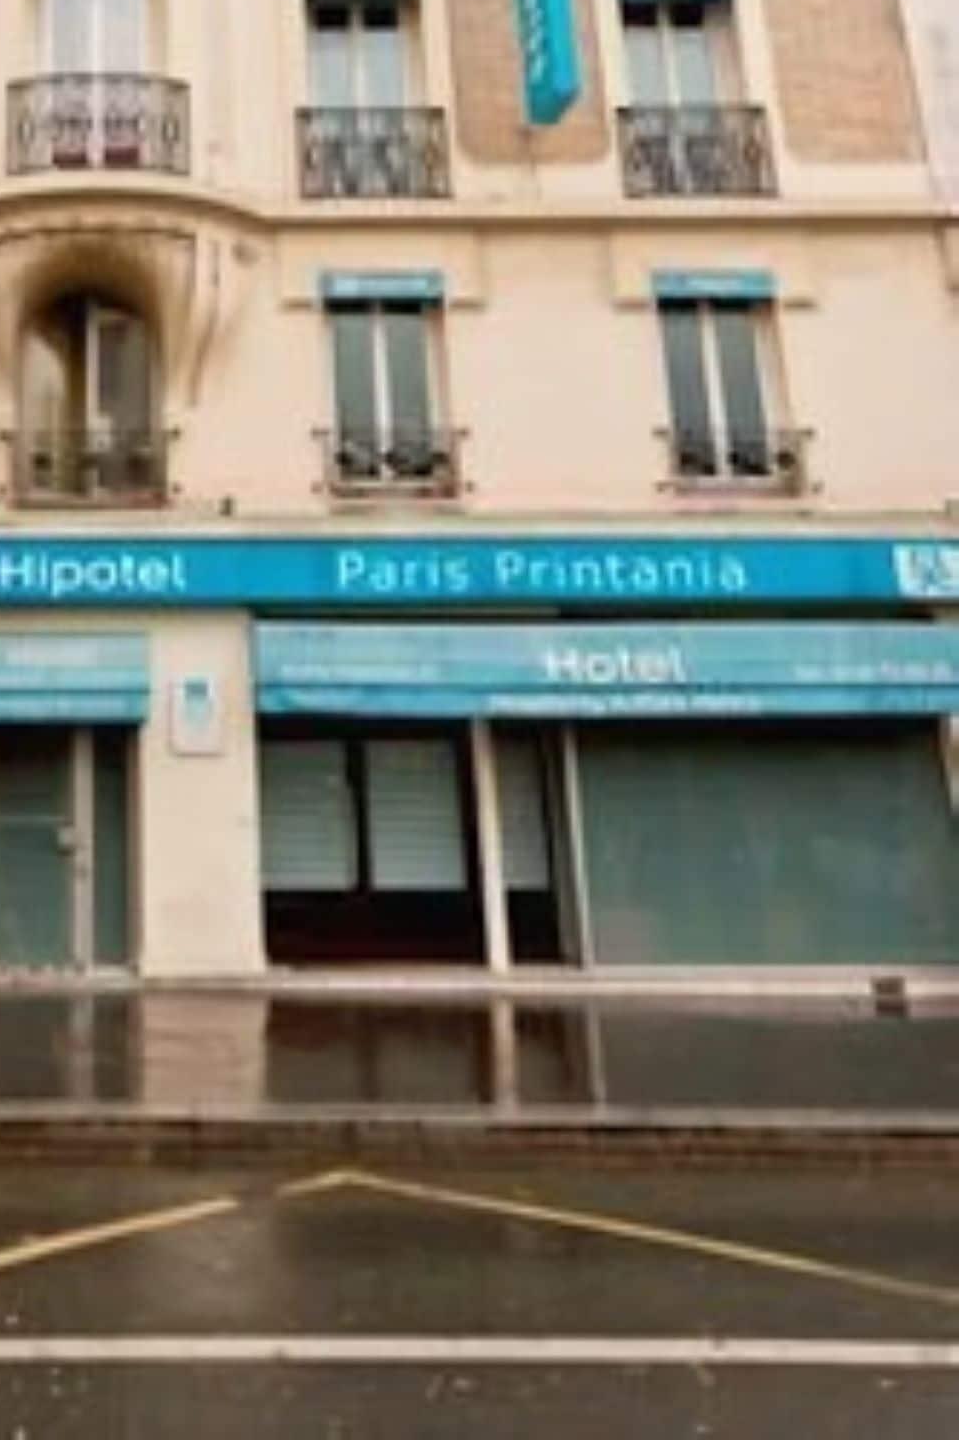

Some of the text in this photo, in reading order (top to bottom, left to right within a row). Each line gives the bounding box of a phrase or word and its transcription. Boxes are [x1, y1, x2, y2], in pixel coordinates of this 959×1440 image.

[337, 549, 748, 594] Paris Printania
[544, 645, 689, 684] Hotel
